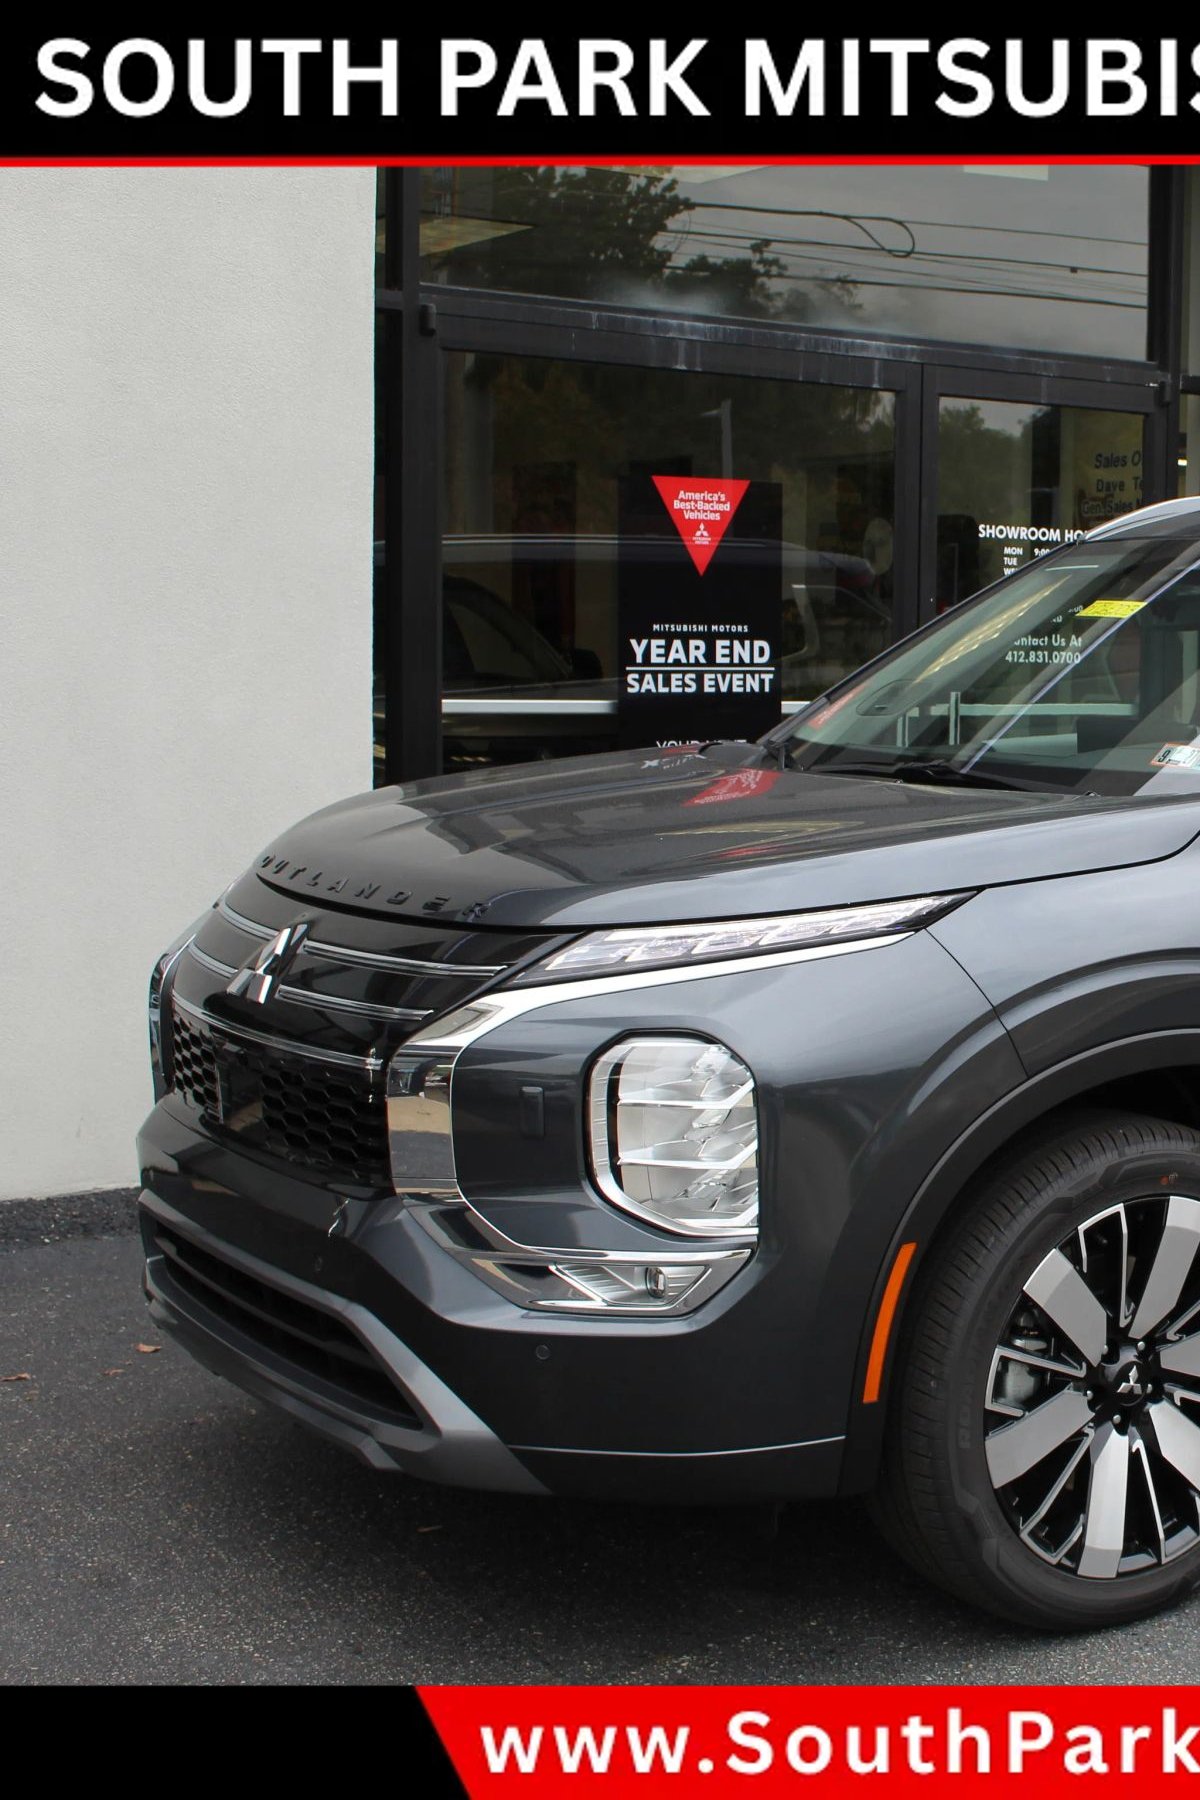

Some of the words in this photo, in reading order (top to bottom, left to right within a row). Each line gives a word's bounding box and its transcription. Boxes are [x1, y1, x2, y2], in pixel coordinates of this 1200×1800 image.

[1094, 453, 1128, 469] Sales
[1096, 479, 1126, 493] Dave
[678, 490, 726, 501] America's
[673, 499, 731, 511] Best-Backed
[683, 510, 721, 520] Vehicles
[978, 523, 1061, 542] SHOWROOM
[1003, 546, 1023, 555] MON
[1003, 556, 1018, 566] TUE
[652, 623, 708, 632] MITSUBISHI
[711, 624, 749, 633] MOTORS
[1051, 634, 1066, 647] Us
[1069, 634, 1083, 647] At
[630, 638, 706, 664] YEAR
[715, 639, 770, 664] END
[1005, 650, 1081, 664] 412.831.0700
[626, 673, 697, 693] SALES
[703, 673, 774, 693] EVENT
